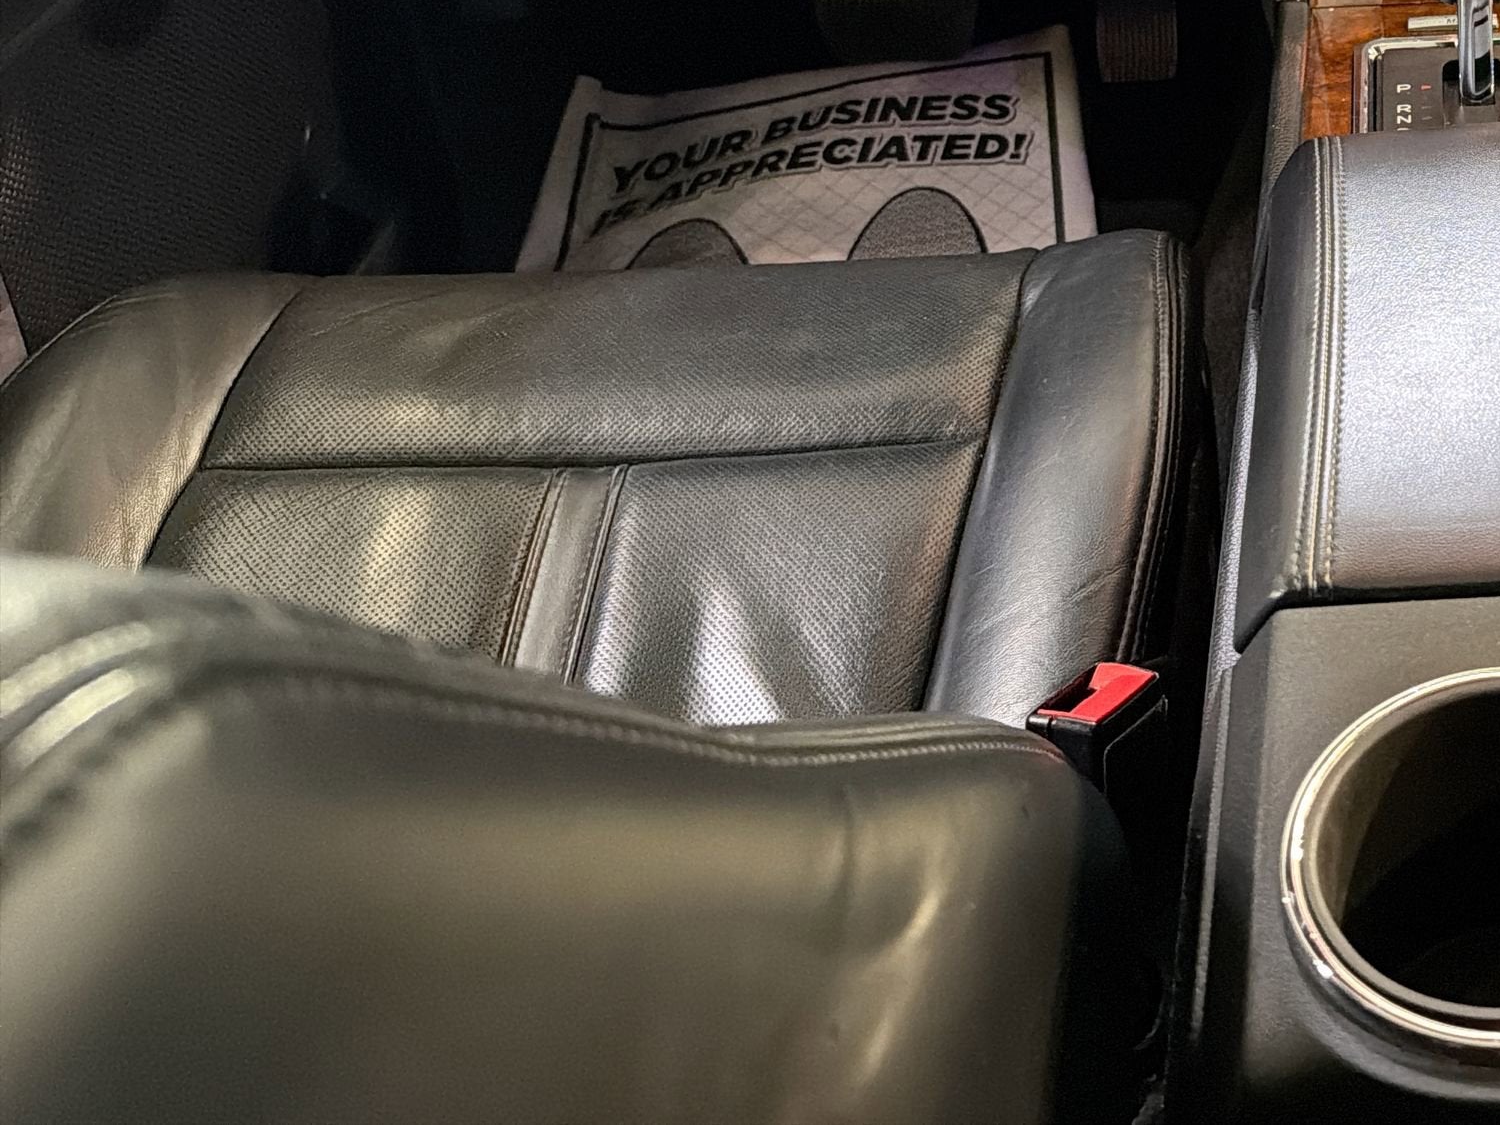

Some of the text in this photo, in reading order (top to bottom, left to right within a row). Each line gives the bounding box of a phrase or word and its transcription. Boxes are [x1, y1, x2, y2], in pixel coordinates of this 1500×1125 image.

[1396, 83, 1412, 93] P
[1396, 104, 1412, 114] R
[1396, 114, 1412, 124] N
[614, 93, 1013, 194] YOUR BUSINESS
[647, 133, 1028, 212] APPRECIATED!
